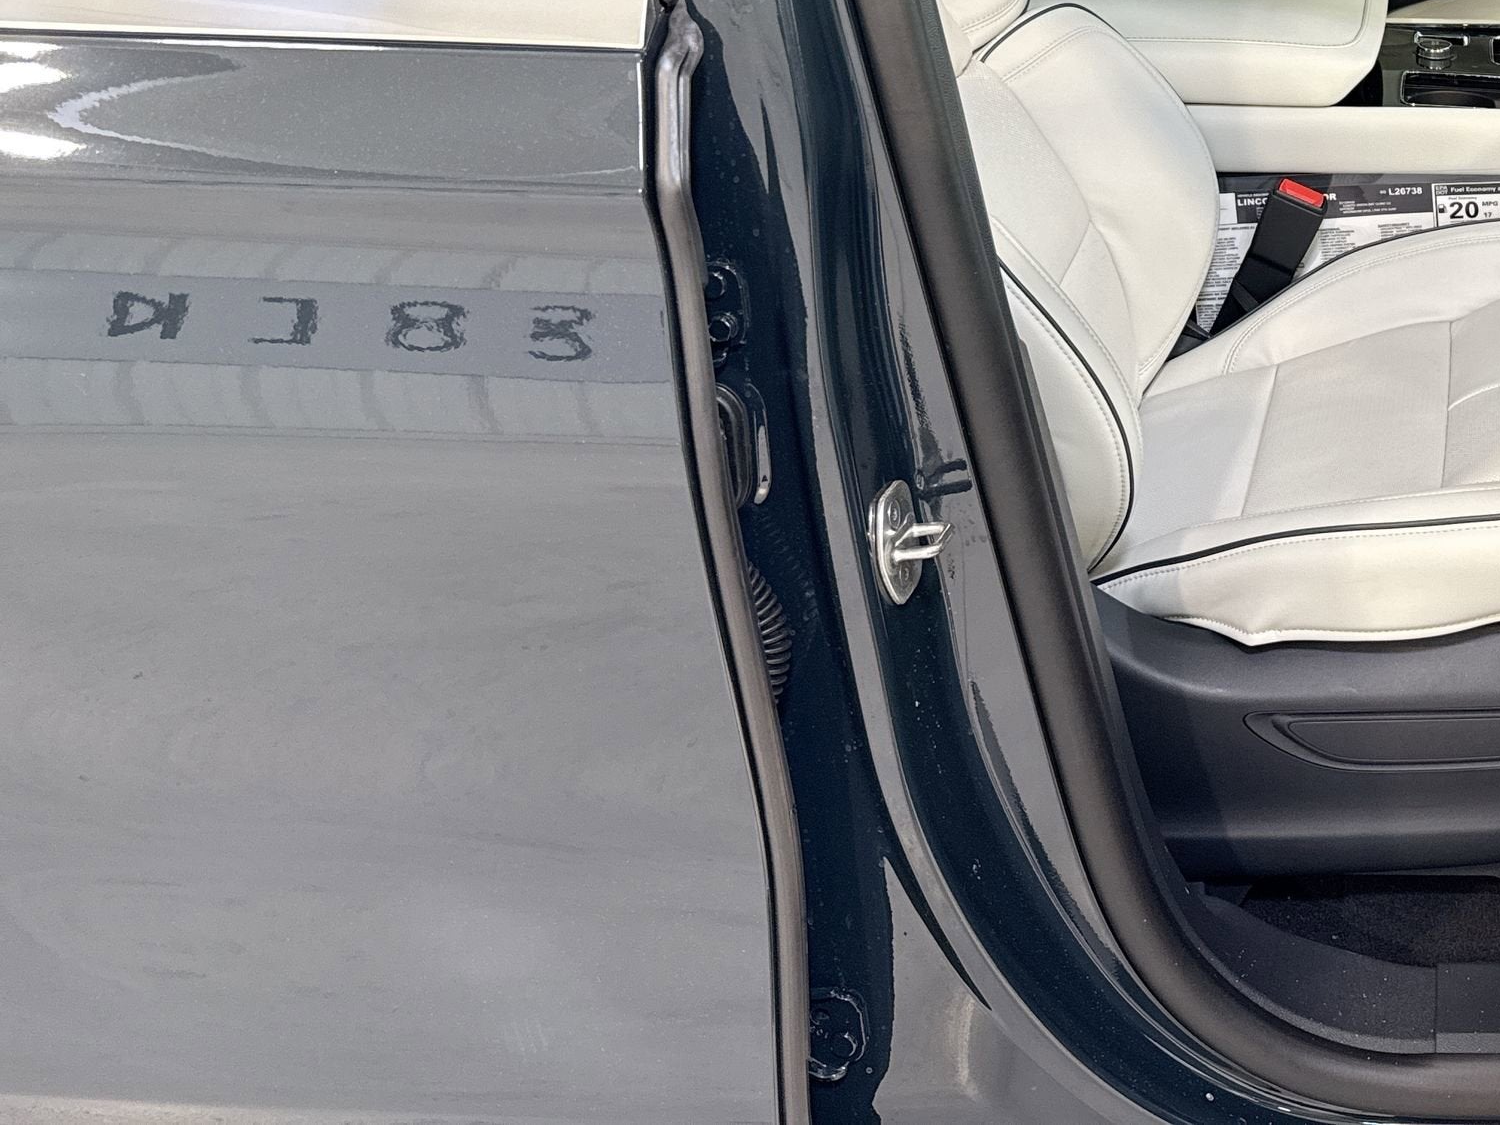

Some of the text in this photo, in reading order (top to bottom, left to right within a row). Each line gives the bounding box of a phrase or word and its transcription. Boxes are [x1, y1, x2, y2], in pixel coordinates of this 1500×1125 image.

[1388, 187, 1422, 196] L26738
[1466, 185, 1496, 193] Economy
[1449, 201, 1479, 220] 20
